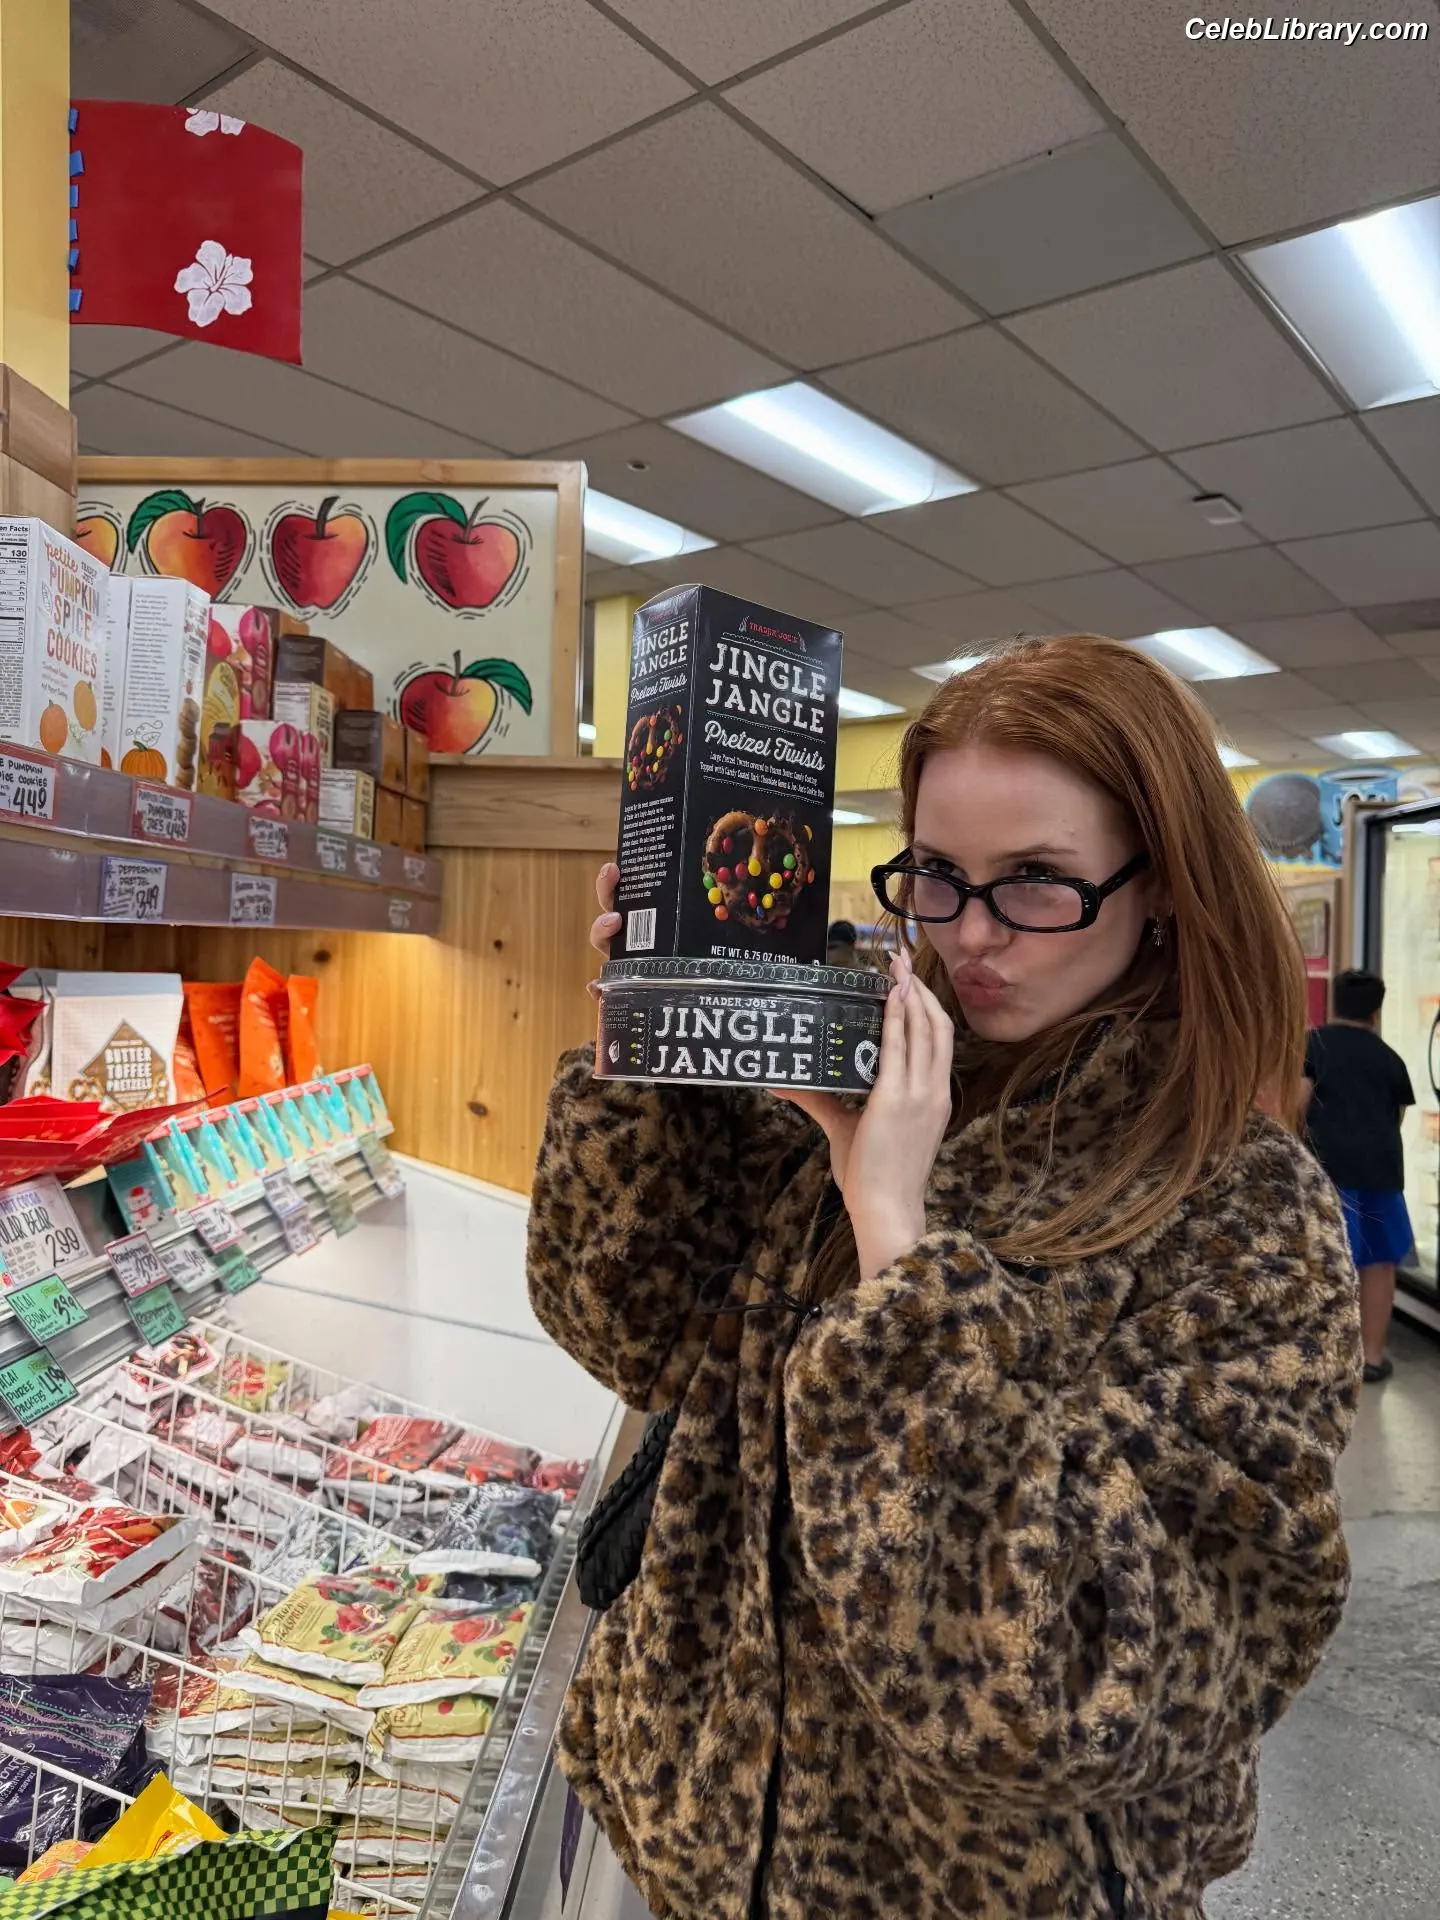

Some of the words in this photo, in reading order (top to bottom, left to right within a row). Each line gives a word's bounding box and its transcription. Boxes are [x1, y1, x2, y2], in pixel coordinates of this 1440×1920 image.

[11, 550, 27, 558] 130
[49, 560, 99, 616] PUMPKIN
[53, 594, 92, 642] SPICE
[47, 628, 98, 679] COOKIES
[634, 621, 689, 660] JINGLE
[632, 645, 688, 680] JANGLE
[709, 643, 826, 702] JINGLE
[630, 681, 659, 703] Pretzel
[659, 672, 688, 693] Twists
[706, 678, 825, 734] JANGLE
[704, 720, 771, 756] Pretzel
[773, 737, 825, 771] Twists
[8, 760, 43, 774] PUMPKIN
[711, 945, 727, 957] NET
[728, 947, 742, 959] WT.
[744, 949, 761, 961] 6.75
[762, 952, 773, 963] OZ
[699, 995, 741, 1008] TRADER
[745, 997, 778, 1010] JOE'S
[655, 1005, 815, 1044] JINGLE
[105, 1047, 152, 1065] BUTTER
[105, 1063, 152, 1080] TOFFEE
[651, 1045, 814, 1081] JANGLE
[0, 1215, 28, 1247] OLAR
[21, 1206, 55, 1235] BEAR
[11, 1293, 36, 1313] ACAI
[24, 1308, 52, 1330] BOWL
[0, 1369, 19, 1390] ACAI
[6, 1380, 35, 1404] PUREE
[14, 1390, 47, 1416] PACKETS
